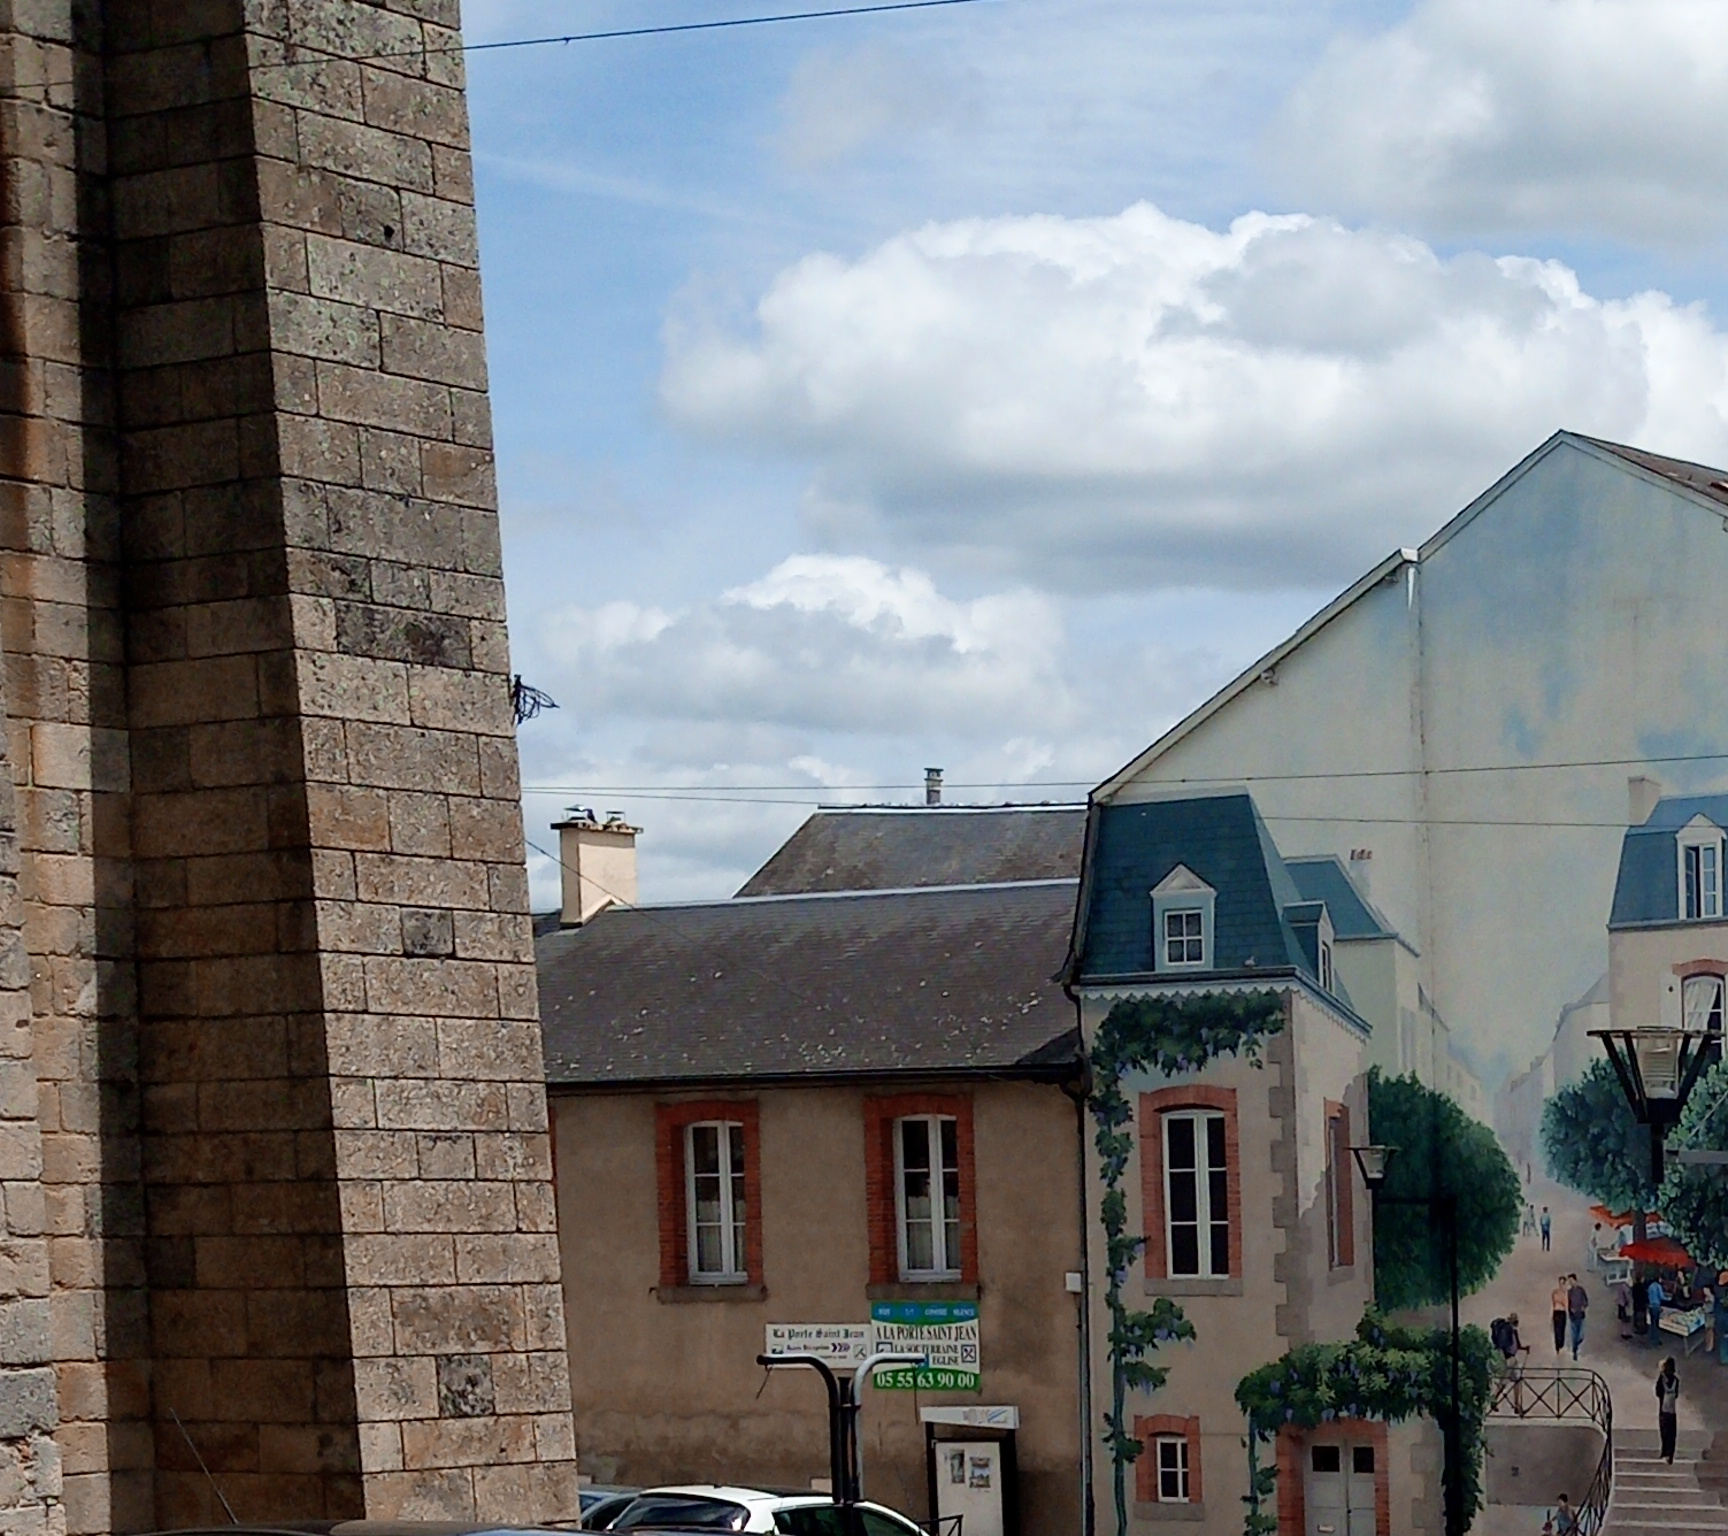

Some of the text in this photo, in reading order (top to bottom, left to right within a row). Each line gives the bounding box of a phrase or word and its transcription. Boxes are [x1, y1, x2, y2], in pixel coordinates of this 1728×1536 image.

[883, 1325, 895, 1340] LA
[897, 1325, 925, 1340] PORTE
[926, 1325, 952, 1340] SAINT
[954, 1325, 977, 1342] JEAN
[876, 1372, 975, 1388] 05 55 63 90 00
